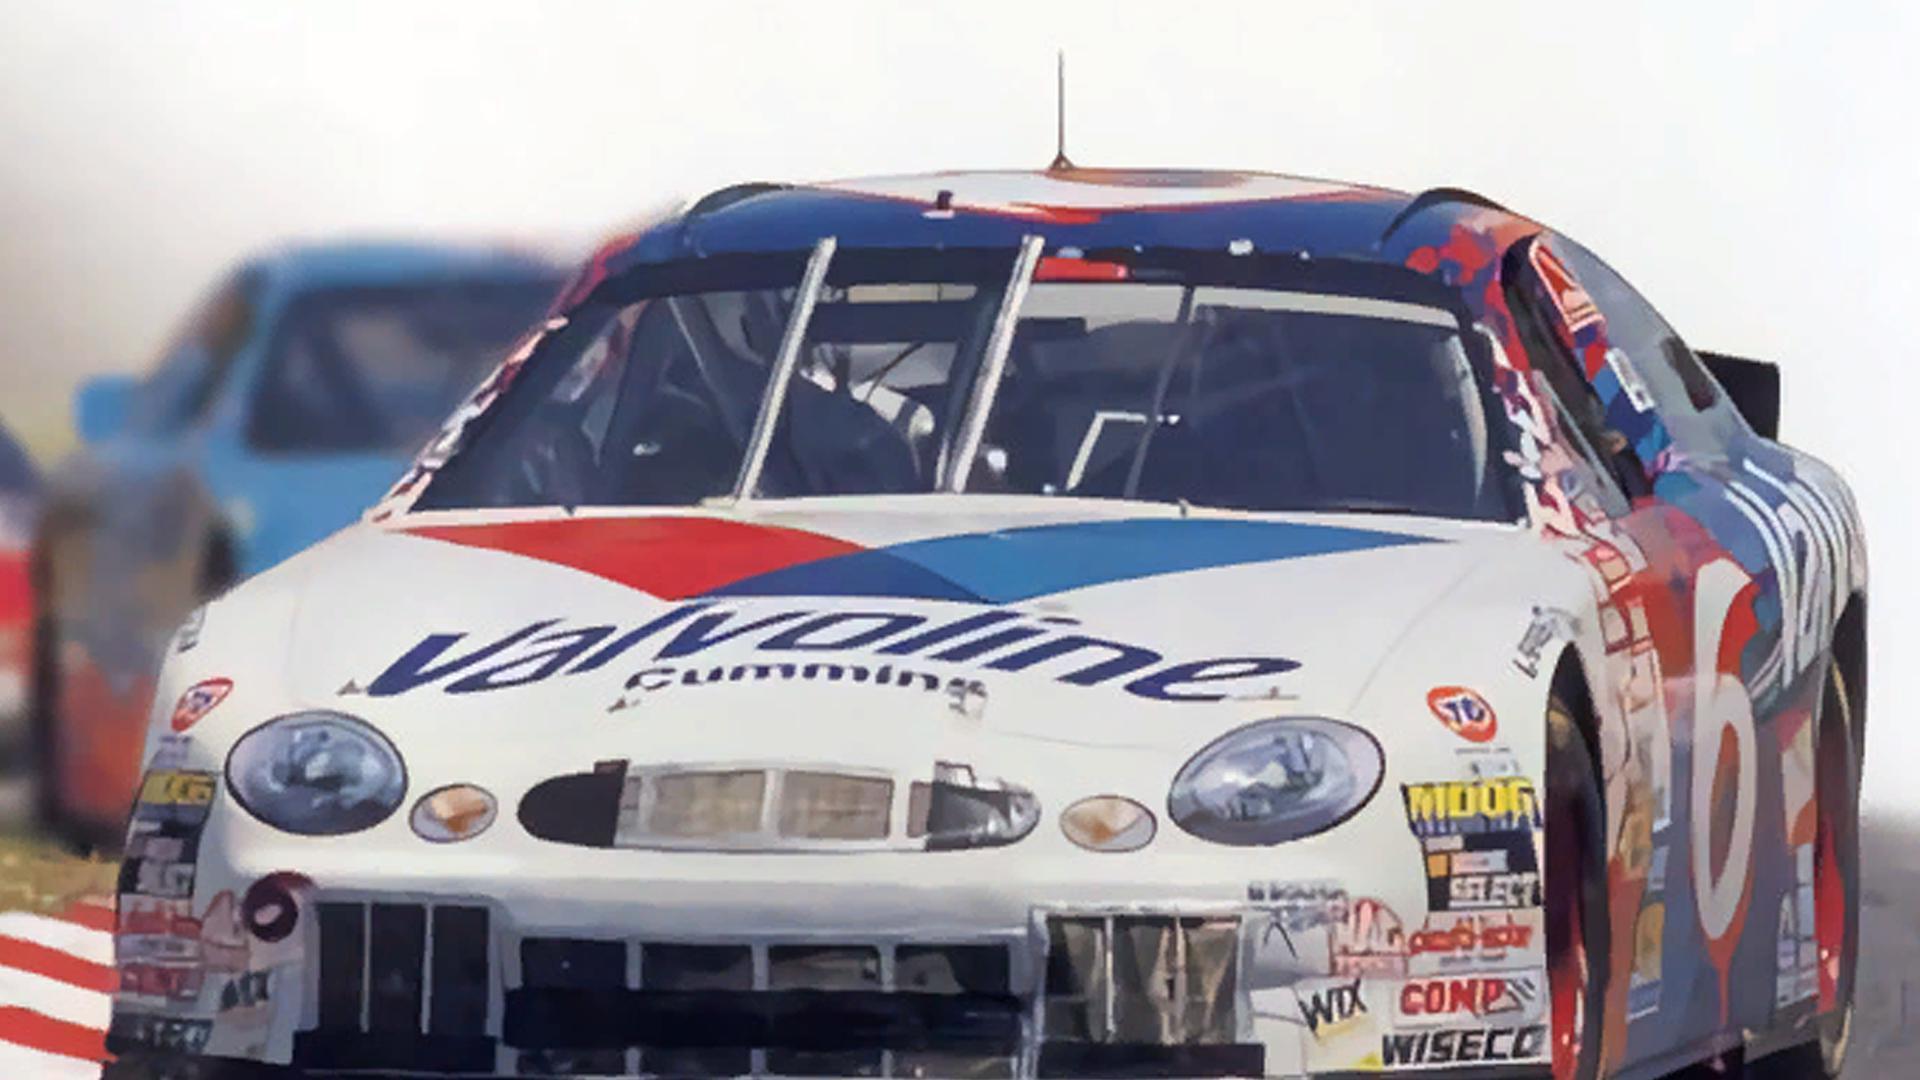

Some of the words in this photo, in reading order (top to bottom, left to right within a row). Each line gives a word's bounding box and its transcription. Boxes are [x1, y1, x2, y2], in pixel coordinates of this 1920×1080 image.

[366, 601, 1302, 702] Valvoline
[1298, 976, 1368, 1032] WIX
[1382, 1024, 1546, 1066] WISECO
